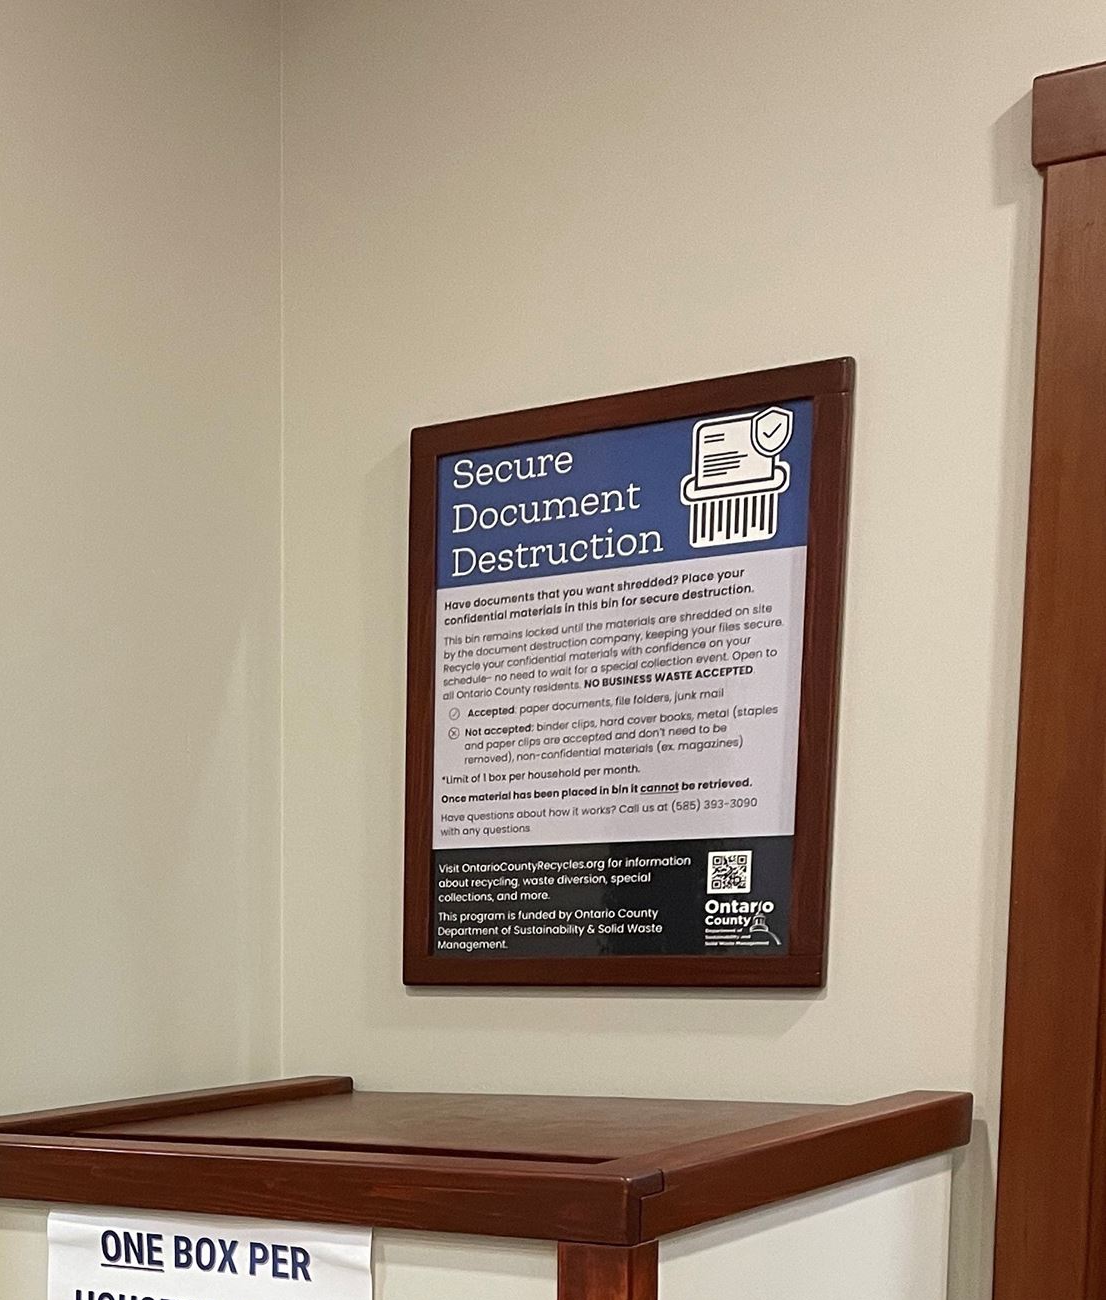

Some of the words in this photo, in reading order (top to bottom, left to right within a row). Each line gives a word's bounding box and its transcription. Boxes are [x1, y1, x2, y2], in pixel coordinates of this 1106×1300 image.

[453, 451, 573, 489] Secure
[452, 483, 641, 534] Document
[451, 530, 664, 577] Destruction
[444, 600, 471, 611] Have
[473, 592, 535, 608] documents
[537, 588, 560, 601] that
[562, 588, 584, 601] you
[585, 582, 615, 595] want
[617, 574, 679, 592] shredded?
[681, 572, 715, 584] Place
[716, 569, 745, 584] your
[444, 609, 507, 626] confidential
[509, 604, 562, 619] materials
[564, 602, 575, 613] in
[577, 599, 598, 612] this
[600, 597, 619, 609] bin
[621, 595, 638, 607] for
[639, 592, 680, 605] secure
[681, 583, 754, 601] destruction.
[443, 635, 463, 647] This
[464, 633, 481, 644] bin
[482, 630, 523, 643] remains
[525, 625, 559, 638] locked
[561, 622, 584, 635] until
[585, 622, 603, 632] the
[605, 615, 656, 630] materials
[679, 607, 733, 623] shredded
[752, 603, 773, 615] site
[442, 660, 481, 674] Recycle
[482, 659, 505, 672] your
[506, 651, 567, 668] confidential
[568, 647, 619, 662] materials
[620, 645, 643, 657] with
[644, 640, 707, 654] confidence
[725, 636, 751, 650] your
[443, 650, 456, 661] by
[457, 648, 474, 658] the
[475, 643, 528, 657] document
[529, 637, 588, 651] destruction
[645, 627, 689, 641] keeping
[691, 624, 717, 638] your
[718, 622, 741, 633] files
[509, 669, 536, 681] need
[549, 666, 572, 677] wait
[600, 659, 639, 675] special
[640, 655, 694, 669] collection
[731, 650, 763, 663] Open
[442, 691, 455, 701] all
[456, 689, 493, 699] Ontario
[494, 685, 531, 696] County
[583, 678, 600, 689] NO
[601, 673, 652, 687] BUSINESS
[654, 670, 693, 683] WASTE
[519, 703, 550, 717] paper
[551, 698, 613, 711] documents,
[615, 695, 631, 706] file
[633, 693, 672, 705] folders,
[674, 690, 697, 705] junk
[699, 687, 724, 700] mail
[464, 727, 482, 737] Not
[536, 721, 570, 732] binder
[571, 719, 598, 731] clips,
[599, 715, 625, 727] hard
[626, 714, 658, 725] cover
[659, 711, 695, 723] books,
[696, 708, 730, 720] metal
[732, 705, 778, 719] (staples
[464, 740, 484, 751] and
[485, 739, 516, 752] paper
[517, 737, 541, 749] clips
[542, 736, 561, 745] are
[562, 730, 613, 745] accepted
[614, 728, 637, 740] and
[638, 727, 666, 739] don't
[668, 725, 696, 736] need
[464, 750, 515, 765] removed),
[516, 746, 602, 762] non-confidential
[603, 743, 654, 756] materials
[677, 734, 744, 753] magazines)
[470, 773, 481, 784] of
[488, 773, 507, 782] box
[508, 772, 526, 784] per
[527, 767, 582, 780] household
[583, 768, 601, 779] per
[603, 764, 641, 776] month.
[441, 794, 467, 804] Once
[468, 790, 512, 803] material
[512, 790, 532, 800] has
[533, 789, 560, 799] been
[561, 785, 598, 800] placed
[599, 785, 610, 795] in
[611, 783, 629, 795] bin
[630, 783, 639, 793] it
[639, 782, 680, 795] cannot
[681, 781, 696, 791] be
[697, 777, 753, 790] retrieved.
[440, 813, 465, 823] Have
[466, 811, 515, 824] questions
[516, 808, 547, 819] about
[548, 807, 571, 817] how
[581, 804, 617, 816] works?
[618, 803, 640, 814] Call
[671, 798, 701, 814] (585)
[703, 797, 758, 810] 393-3090
[440, 826, 461, 837] with
[462, 827, 481, 837] any
[482, 824, 531, 837] questions
[438, 863, 460, 874] Visit
[461, 859, 605, 873] OntarioCountyRecycles.org
[607, 857, 623, 868] for
[625, 855, 691, 867] information
[438, 878, 469, 888] about
[522, 876, 555, 886] waste
[556, 873, 608, 885] diversion,
[610, 872, 651, 886] special
[438, 892, 495, 903] collections,
[496, 890, 518, 901] and
[704, 899, 775, 914] Ontario
[437, 926, 499, 938] Department
[500, 925, 512, 935] of
[513, 924, 585, 937] Sustainability
[597, 923, 625, 934] Solid
[627, 923, 663, 933] Waste
[438, 911, 458, 922] This
[459, 912, 506, 924] program
[507, 910, 516, 920] is
[518, 910, 556, 920] funded
[558, 909, 573, 922] by
[574, 908, 616, 919] Ontario
[617, 908, 659, 920] County
[704, 915, 752, 927] County
[100, 1229, 164, 1273] ONE
[173, 1235, 238, 1275] BOX
[249, 1242, 312, 1282] PER
